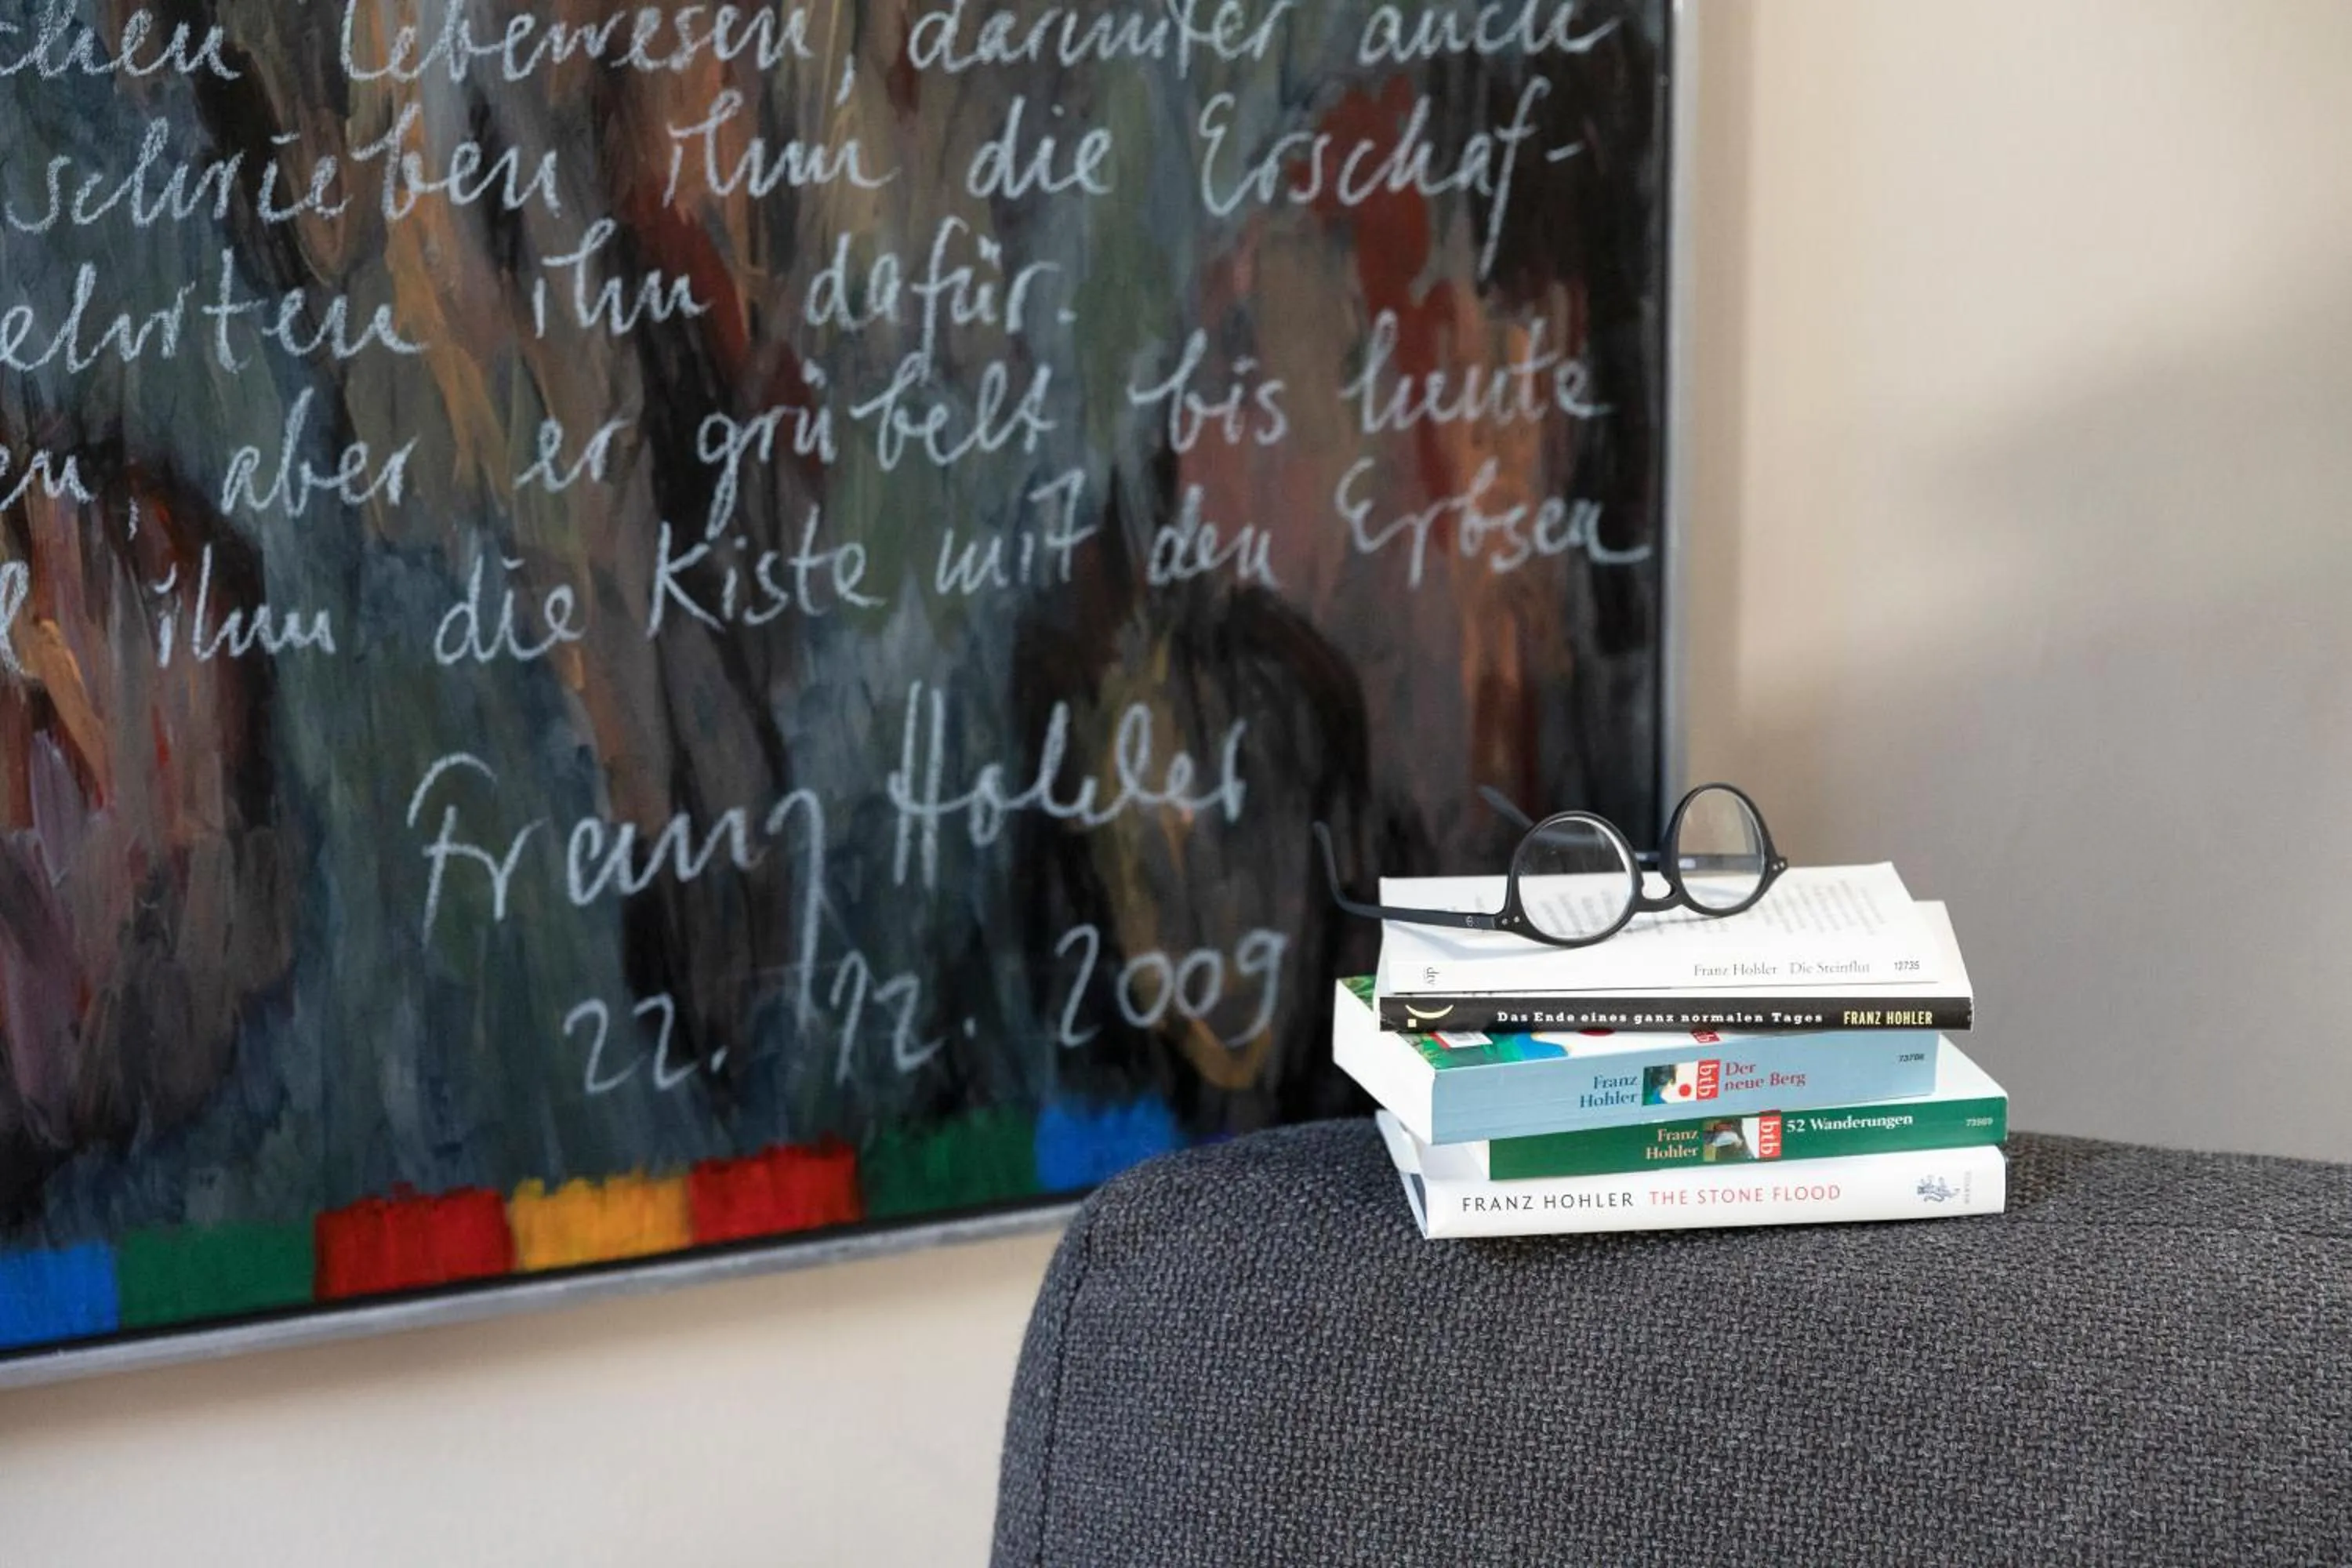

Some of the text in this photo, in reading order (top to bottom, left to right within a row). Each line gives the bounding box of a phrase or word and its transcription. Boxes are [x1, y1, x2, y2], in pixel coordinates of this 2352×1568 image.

[907, 0, 1294, 79] darunter
[1358, 0, 1623, 67] auch
[5, 75, 1584, 281] schrieben ihm die Erschaf-
[533, 218, 712, 339] ihn
[804, 216, 1077, 386] dafür.
[221, 386, 419, 517] aber
[514, 416, 630, 492] er
[696, 353, 1058, 539] grübelt
[1127, 327, 1288, 454] bis
[1339, 308, 1613, 434] heute
[154, 543, 337, 668] ihm
[434, 554, 586, 666] die
[646, 503, 888, 639] Kiste
[935, 468, 1097, 596] mit
[1147, 484, 1281, 590] den
[1335, 457, 1653, 592] Erbsen
[405, 680, 1248, 1043] Franz Hohler
[1693, 959, 1871, 977] Franz Hohler Die Steinflut
[562, 992, 729, 1094] 22.
[1054, 923, 1290, 1048] 2009
[1497, 1010, 1824, 1025] Das Ende eines ganz normalen Tages
[1843, 1010, 1933, 1025] FRANZ HOHLER
[1593, 1073, 1639, 1090] Franz
[1697, 1063, 1713, 1097] btb
[1724, 1071, 1806, 1091] neue Berg
[1725, 1061, 1757, 1077] Der
[1579, 1090, 1639, 1108] Hohler
[1657, 1127, 1700, 1142] Franz
[1786, 1113, 1914, 1134] 52 Wanderungen
[1759, 1120, 1774, 1156] btb
[1646, 1144, 1700, 1160] Hohler
[1462, 1184, 1841, 1213] FRANZ HOHLER THE STONE FLOOD
